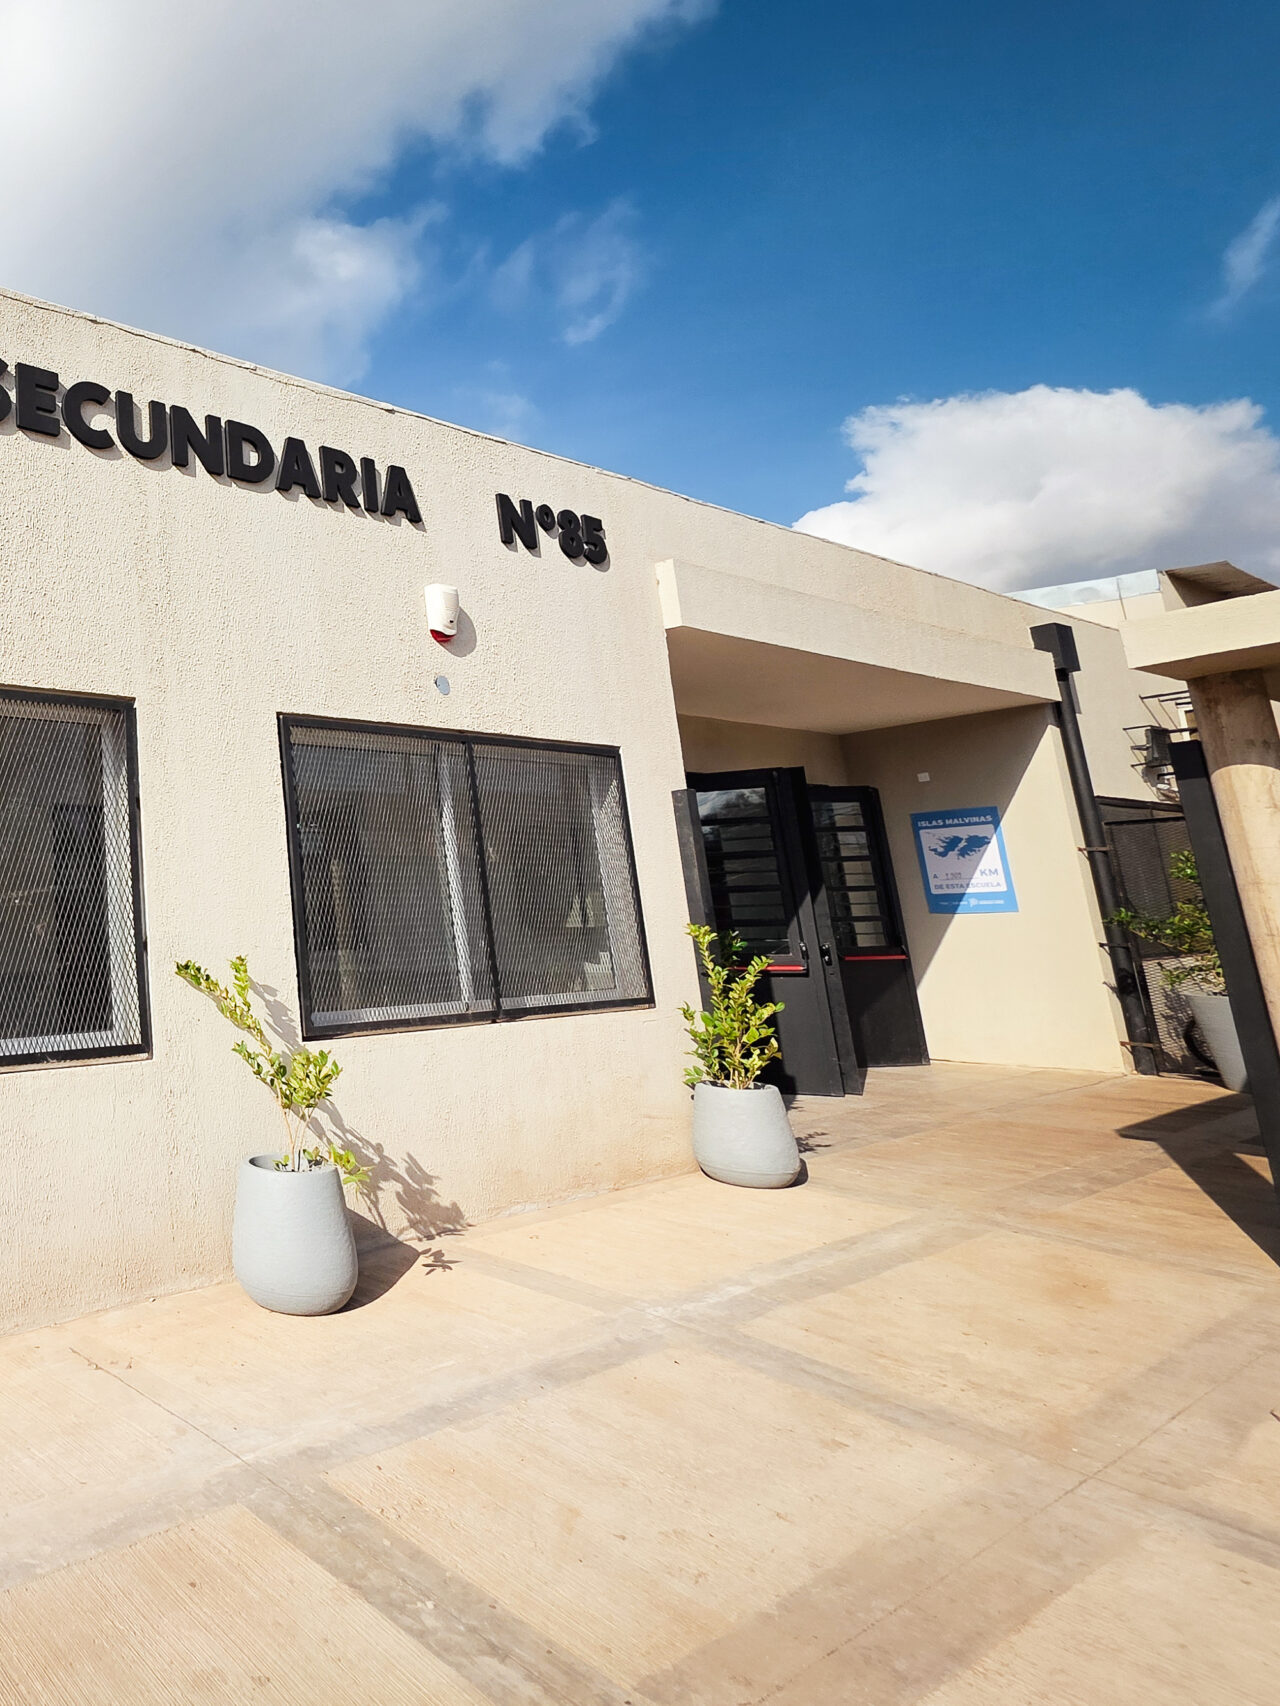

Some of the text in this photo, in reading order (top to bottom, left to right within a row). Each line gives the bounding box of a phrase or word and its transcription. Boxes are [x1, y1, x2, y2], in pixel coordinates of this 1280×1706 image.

[918, 815, 993, 827] ISLAS MALVINAS
[980, 868, 999, 877] KM
